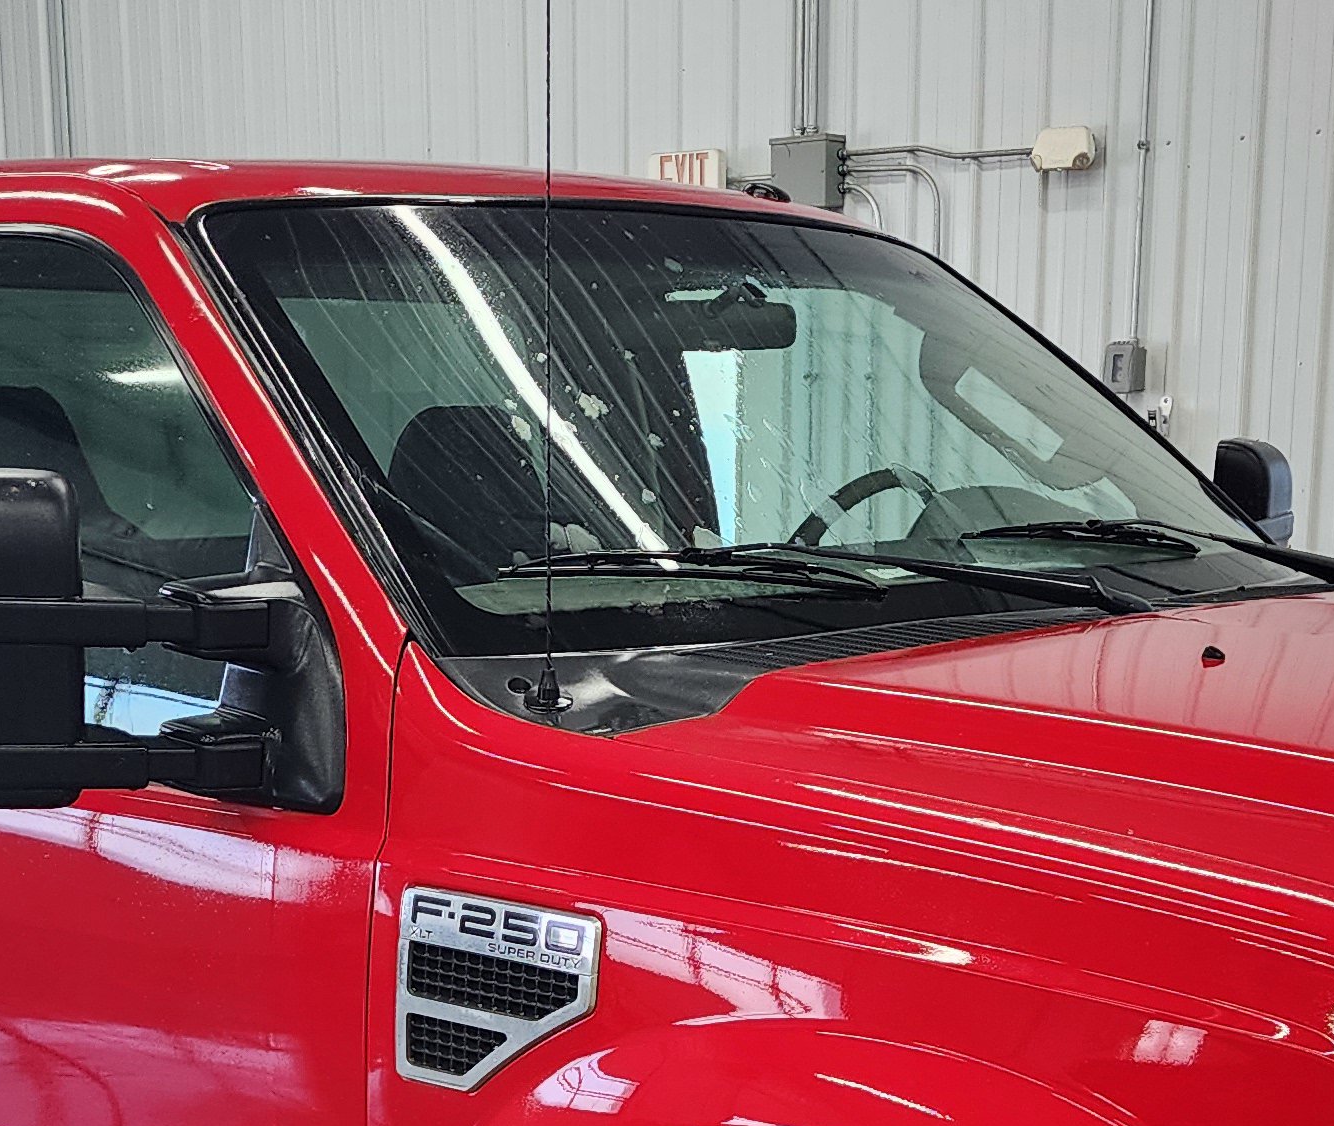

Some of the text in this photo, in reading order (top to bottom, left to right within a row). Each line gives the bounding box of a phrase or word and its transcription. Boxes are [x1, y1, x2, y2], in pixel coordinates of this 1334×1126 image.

[411, 893, 586, 956] F-250
[487, 942, 582, 970] SUPER DUTY
